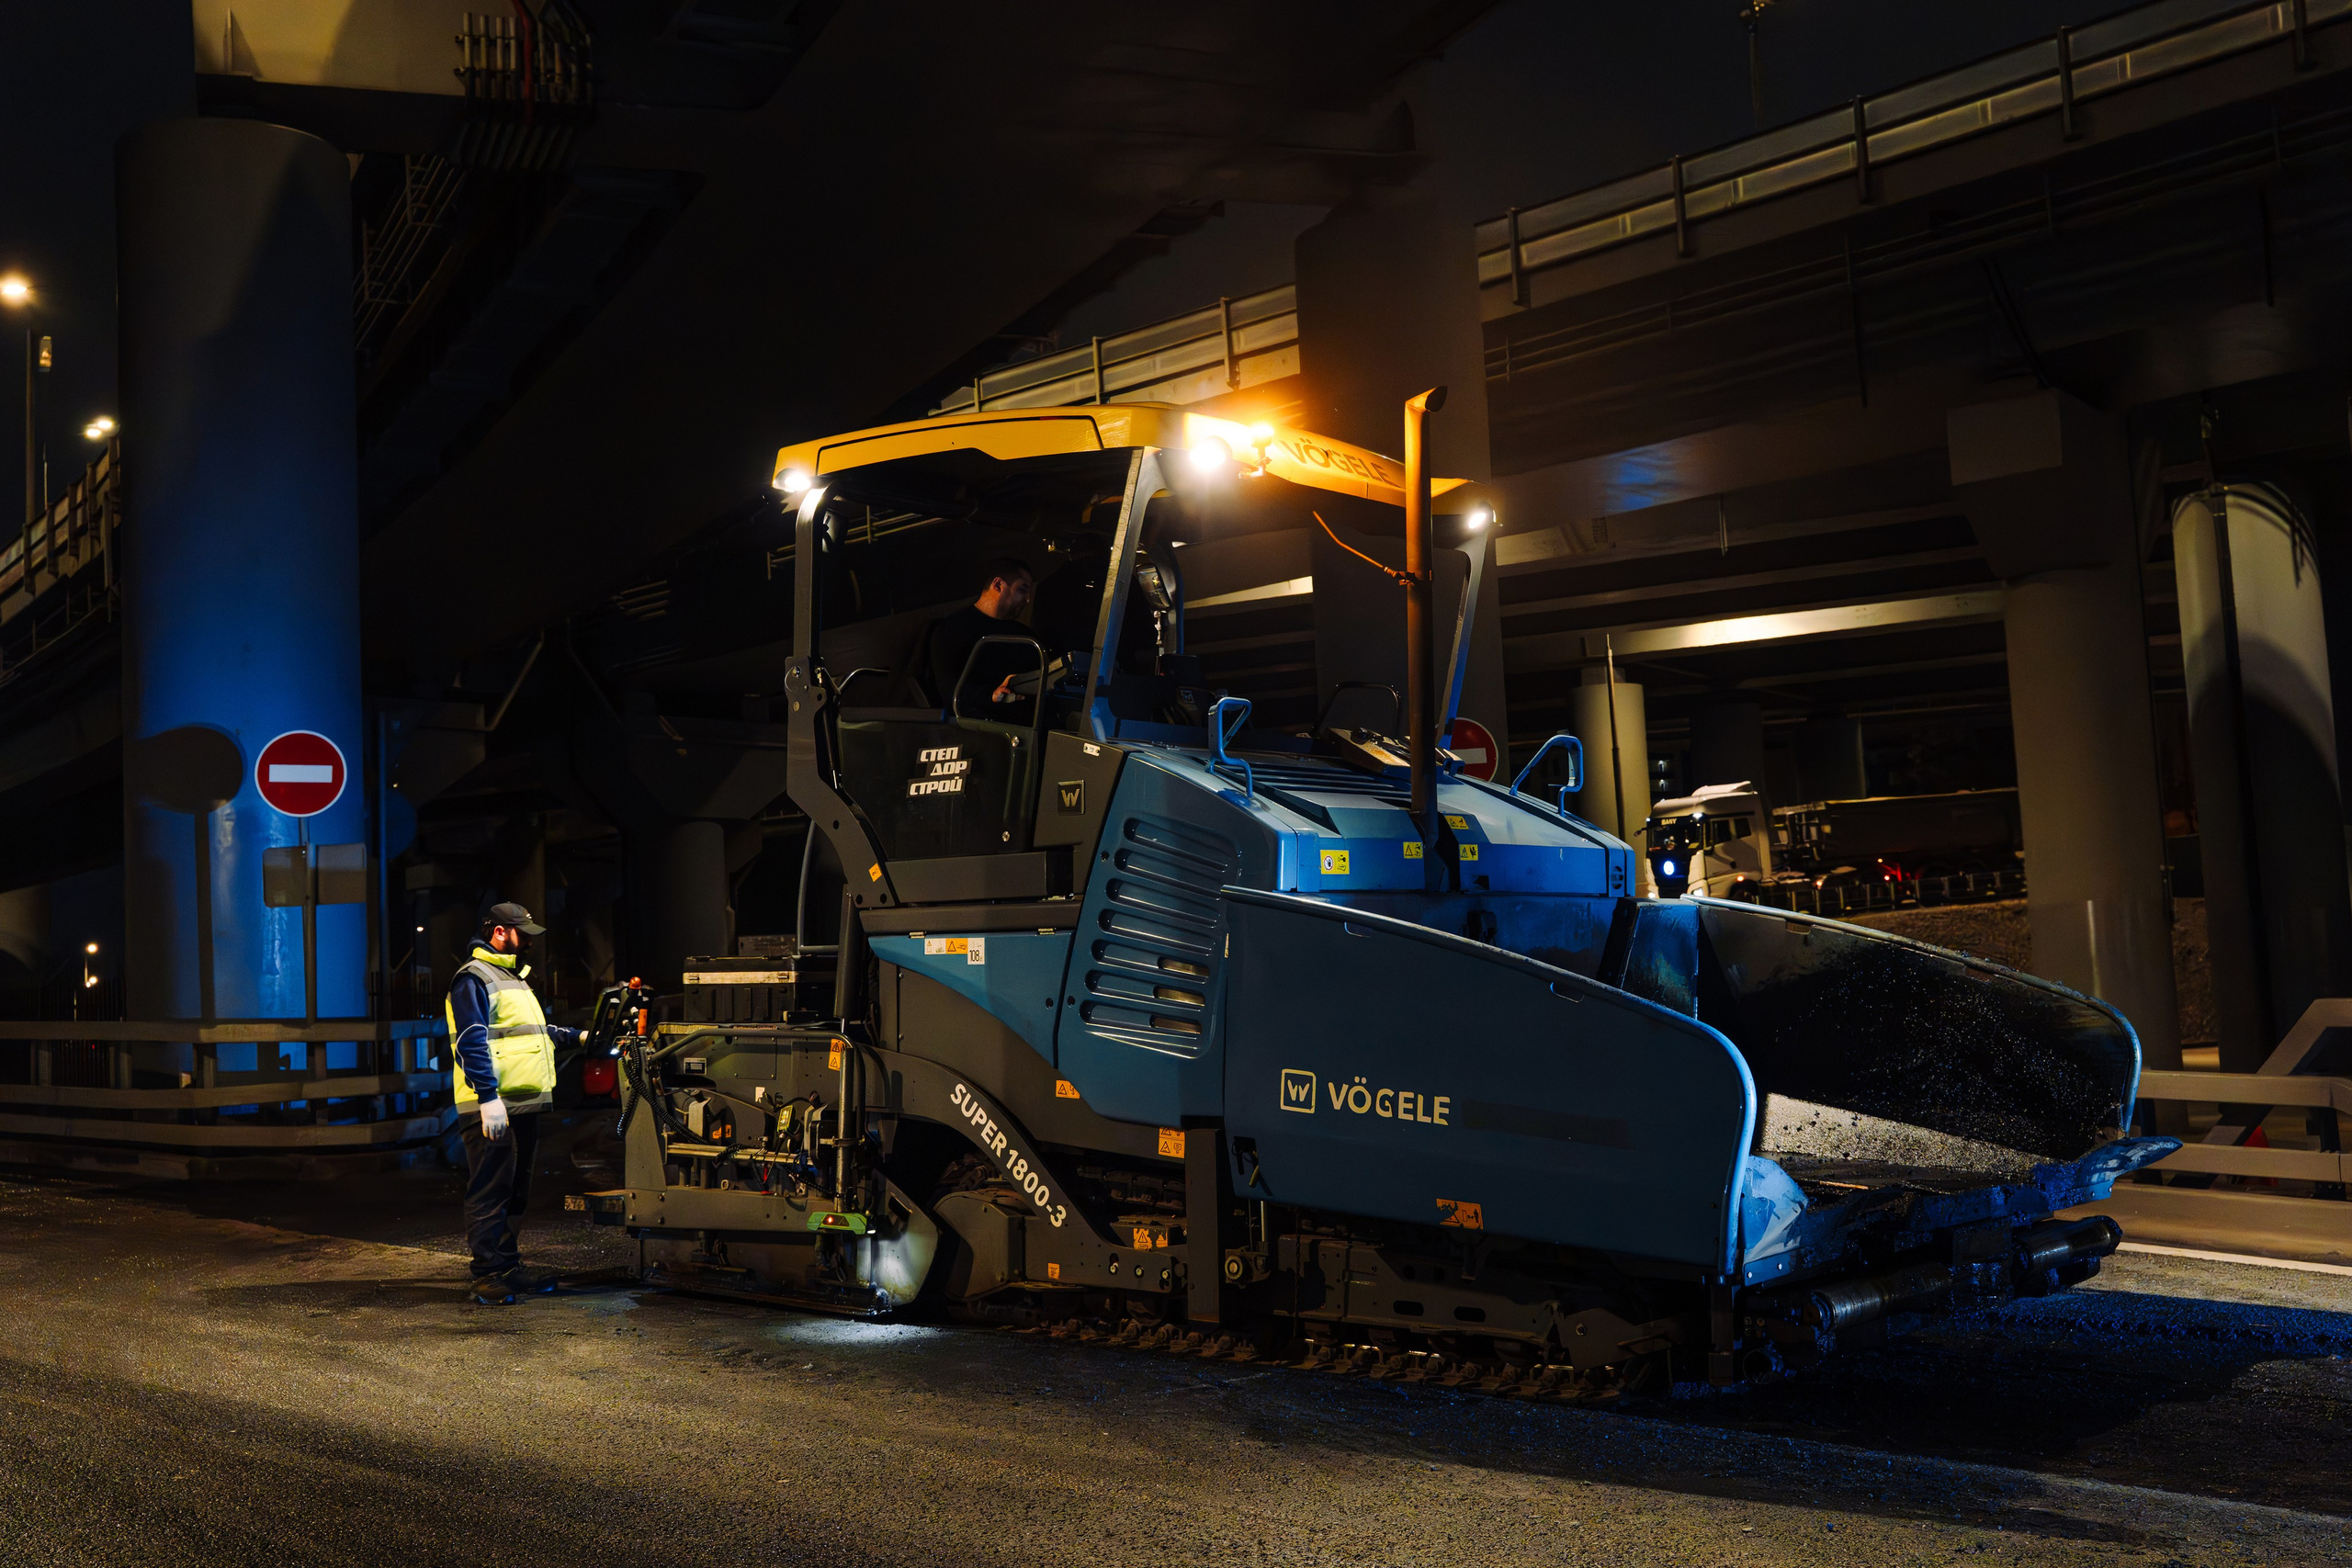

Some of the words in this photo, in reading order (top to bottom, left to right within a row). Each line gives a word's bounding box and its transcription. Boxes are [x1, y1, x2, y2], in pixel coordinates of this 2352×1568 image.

[1280, 437, 1403, 489] VÖGELE
[920, 747, 959, 762] СТЕП
[930, 761, 967, 776] ДОР
[910, 776, 963, 795] СТРОЙ
[969, 949, 980, 962] 108
[1328, 1076, 1451, 1126] VÖGELE
[950, 1083, 1008, 1158] SUPER
[1006, 1149, 1067, 1227] 1800-3
